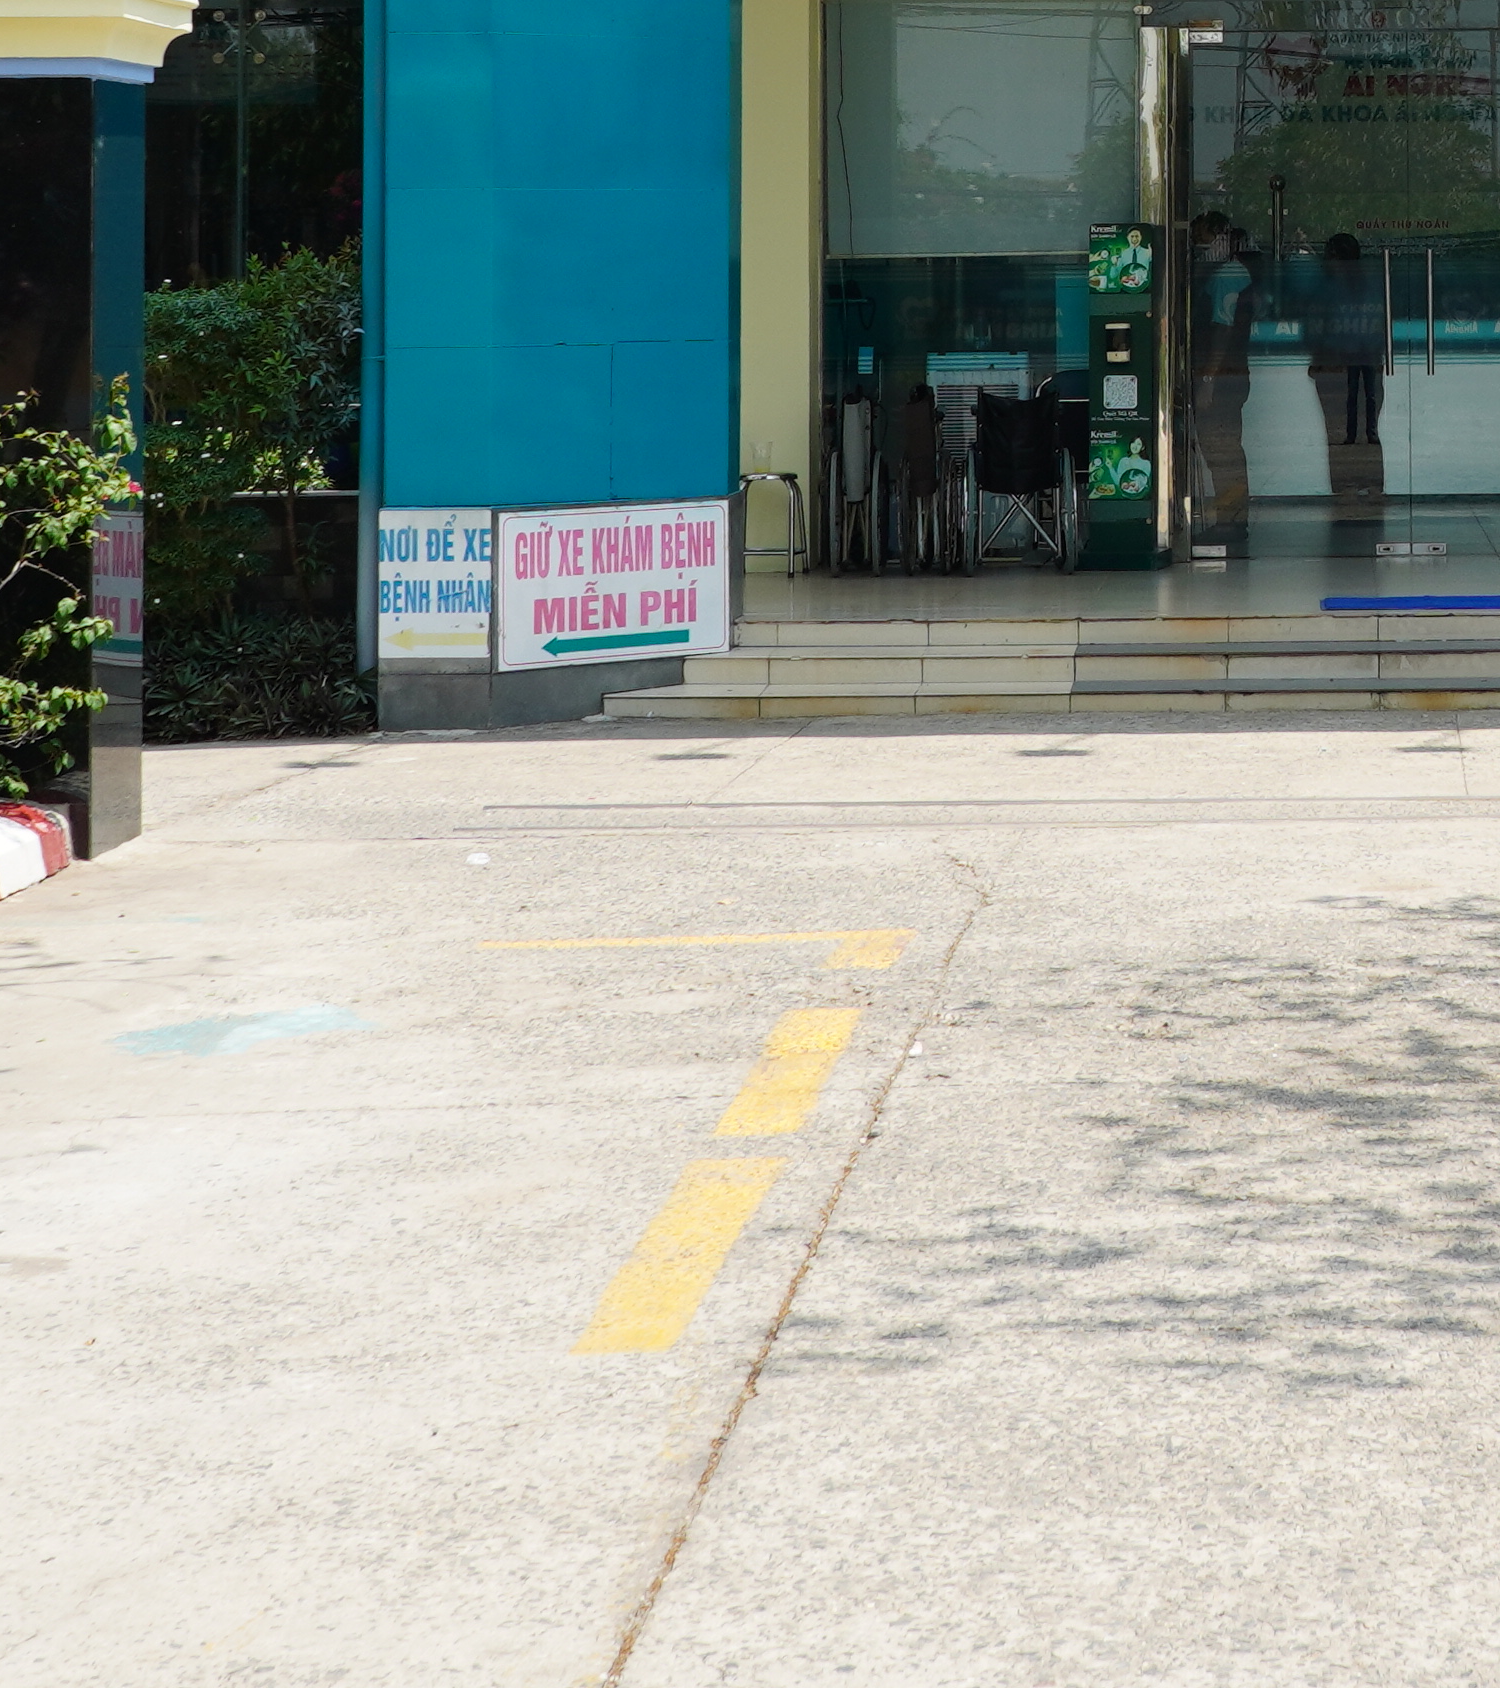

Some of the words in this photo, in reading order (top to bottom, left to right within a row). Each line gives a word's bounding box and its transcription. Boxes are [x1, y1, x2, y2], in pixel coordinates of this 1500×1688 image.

[378, 523, 419, 563] NƠI
[425, 514, 460, 563] ĐỂ
[463, 527, 492, 563] XE
[513, 520, 554, 581] GIỮ
[557, 529, 585, 578] XE
[591, 514, 654, 575] KHÁM
[660, 509, 717, 581] BỆNH
[379, 572, 431, 623] BỆNH
[437, 570, 491, 614] NHÂN
[532, 579, 625, 635] MIỄN
[639, 578, 698, 627] PHÍ
